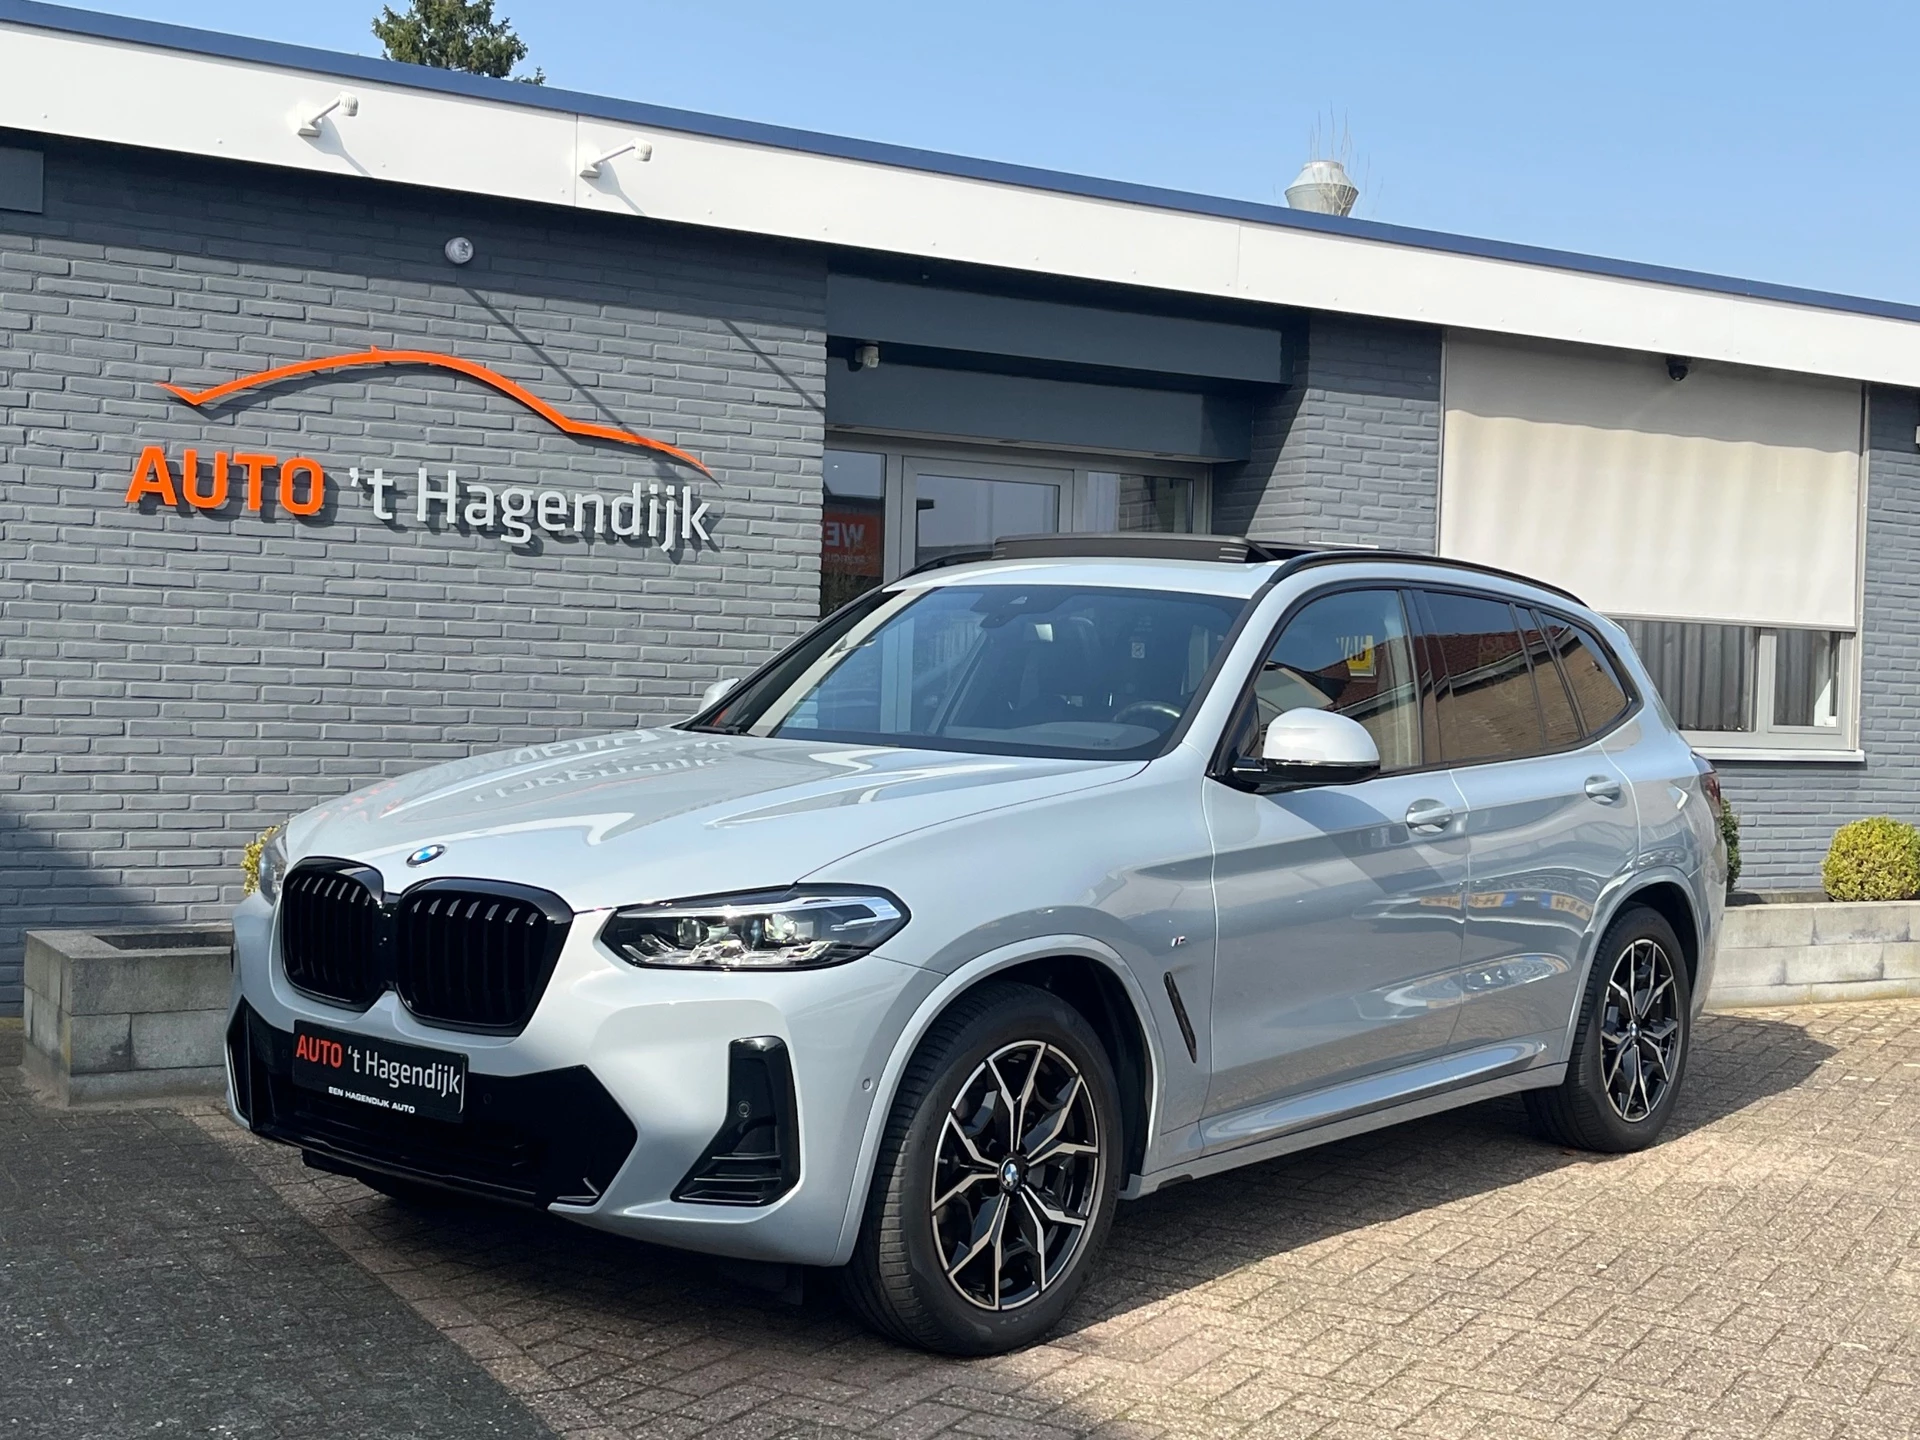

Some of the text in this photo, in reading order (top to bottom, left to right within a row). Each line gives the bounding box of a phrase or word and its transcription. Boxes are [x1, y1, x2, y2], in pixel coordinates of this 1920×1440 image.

[125, 444, 711, 553] AUTO 't Hagendijk
[295, 1034, 461, 1098] AUTO 't Hagendijk
[327, 1086, 416, 1114] EEN HAGENDIJK AUTO
